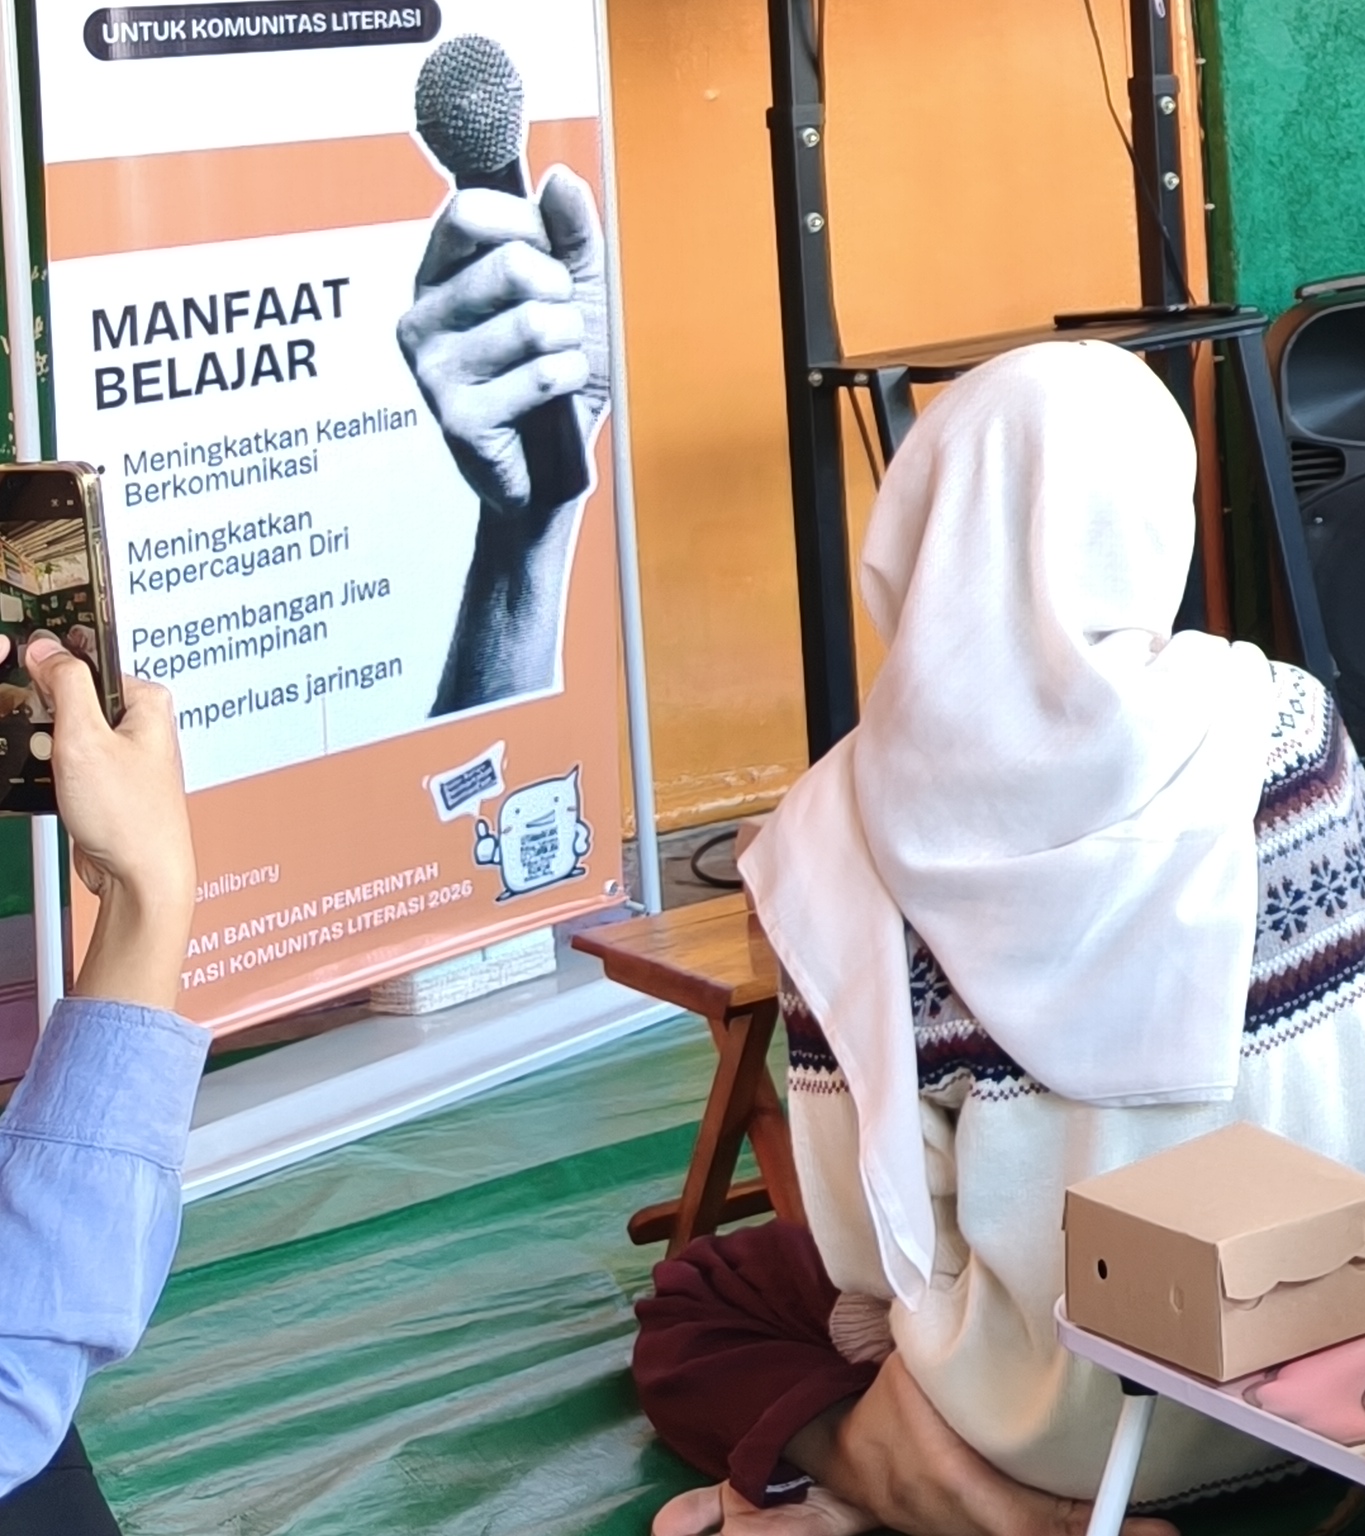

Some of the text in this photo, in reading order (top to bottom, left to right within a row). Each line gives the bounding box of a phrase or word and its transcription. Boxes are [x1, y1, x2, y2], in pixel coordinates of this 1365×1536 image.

[102, 8, 422, 44] UNTUK KOMUNITAS LITERASI
[91, 277, 351, 352] MANFAAT
[94, 339, 318, 410] BELAJAR
[123, 406, 418, 477] Meningkatkan Keahlian
[125, 449, 319, 507] Berkomunikasi
[127, 507, 313, 566] Meningkatkan
[129, 526, 350, 595] Kepercayaan Diri
[132, 574, 392, 654] Pengembangan Jiwa
[133, 620, 328, 681] Kepemimpinan
[179, 654, 403, 730] mperluas jaringan
[194, 863, 281, 903] elalibrary
[223, 900, 318, 946] BANTUAN
[321, 862, 439, 915] PEMERINTAH
[229, 921, 344, 975] KOMUNITAS
[347, 895, 425, 936] LITERASI
